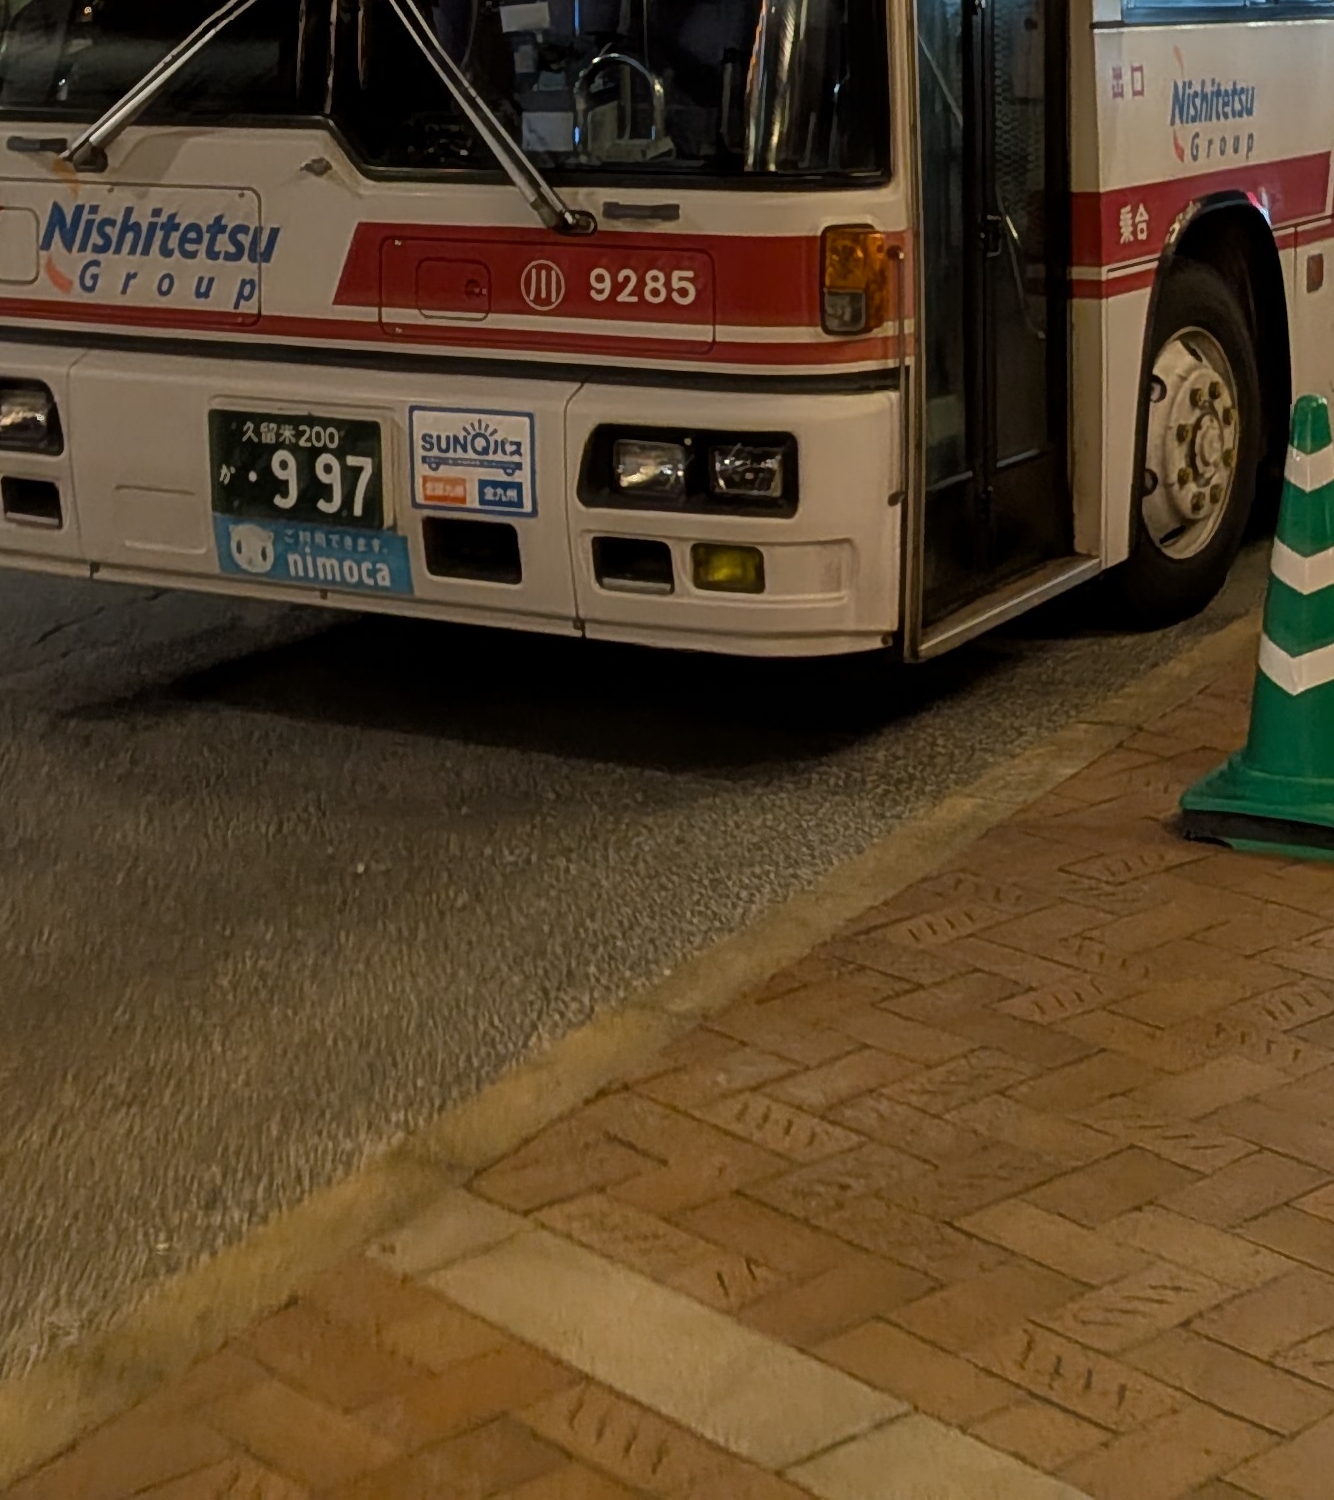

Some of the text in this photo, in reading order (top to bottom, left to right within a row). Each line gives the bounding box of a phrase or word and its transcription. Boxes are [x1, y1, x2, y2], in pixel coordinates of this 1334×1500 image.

[1112, 64, 1145, 99] 出口
[1170, 78, 1256, 127] Nishitetsu
[1190, 131, 1255, 162] Group
[39, 200, 281, 264] Nishitetsu
[78, 259, 257, 310] Group
[589, 267, 697, 306] 9285
[287, 546, 392, 588] nimoca
